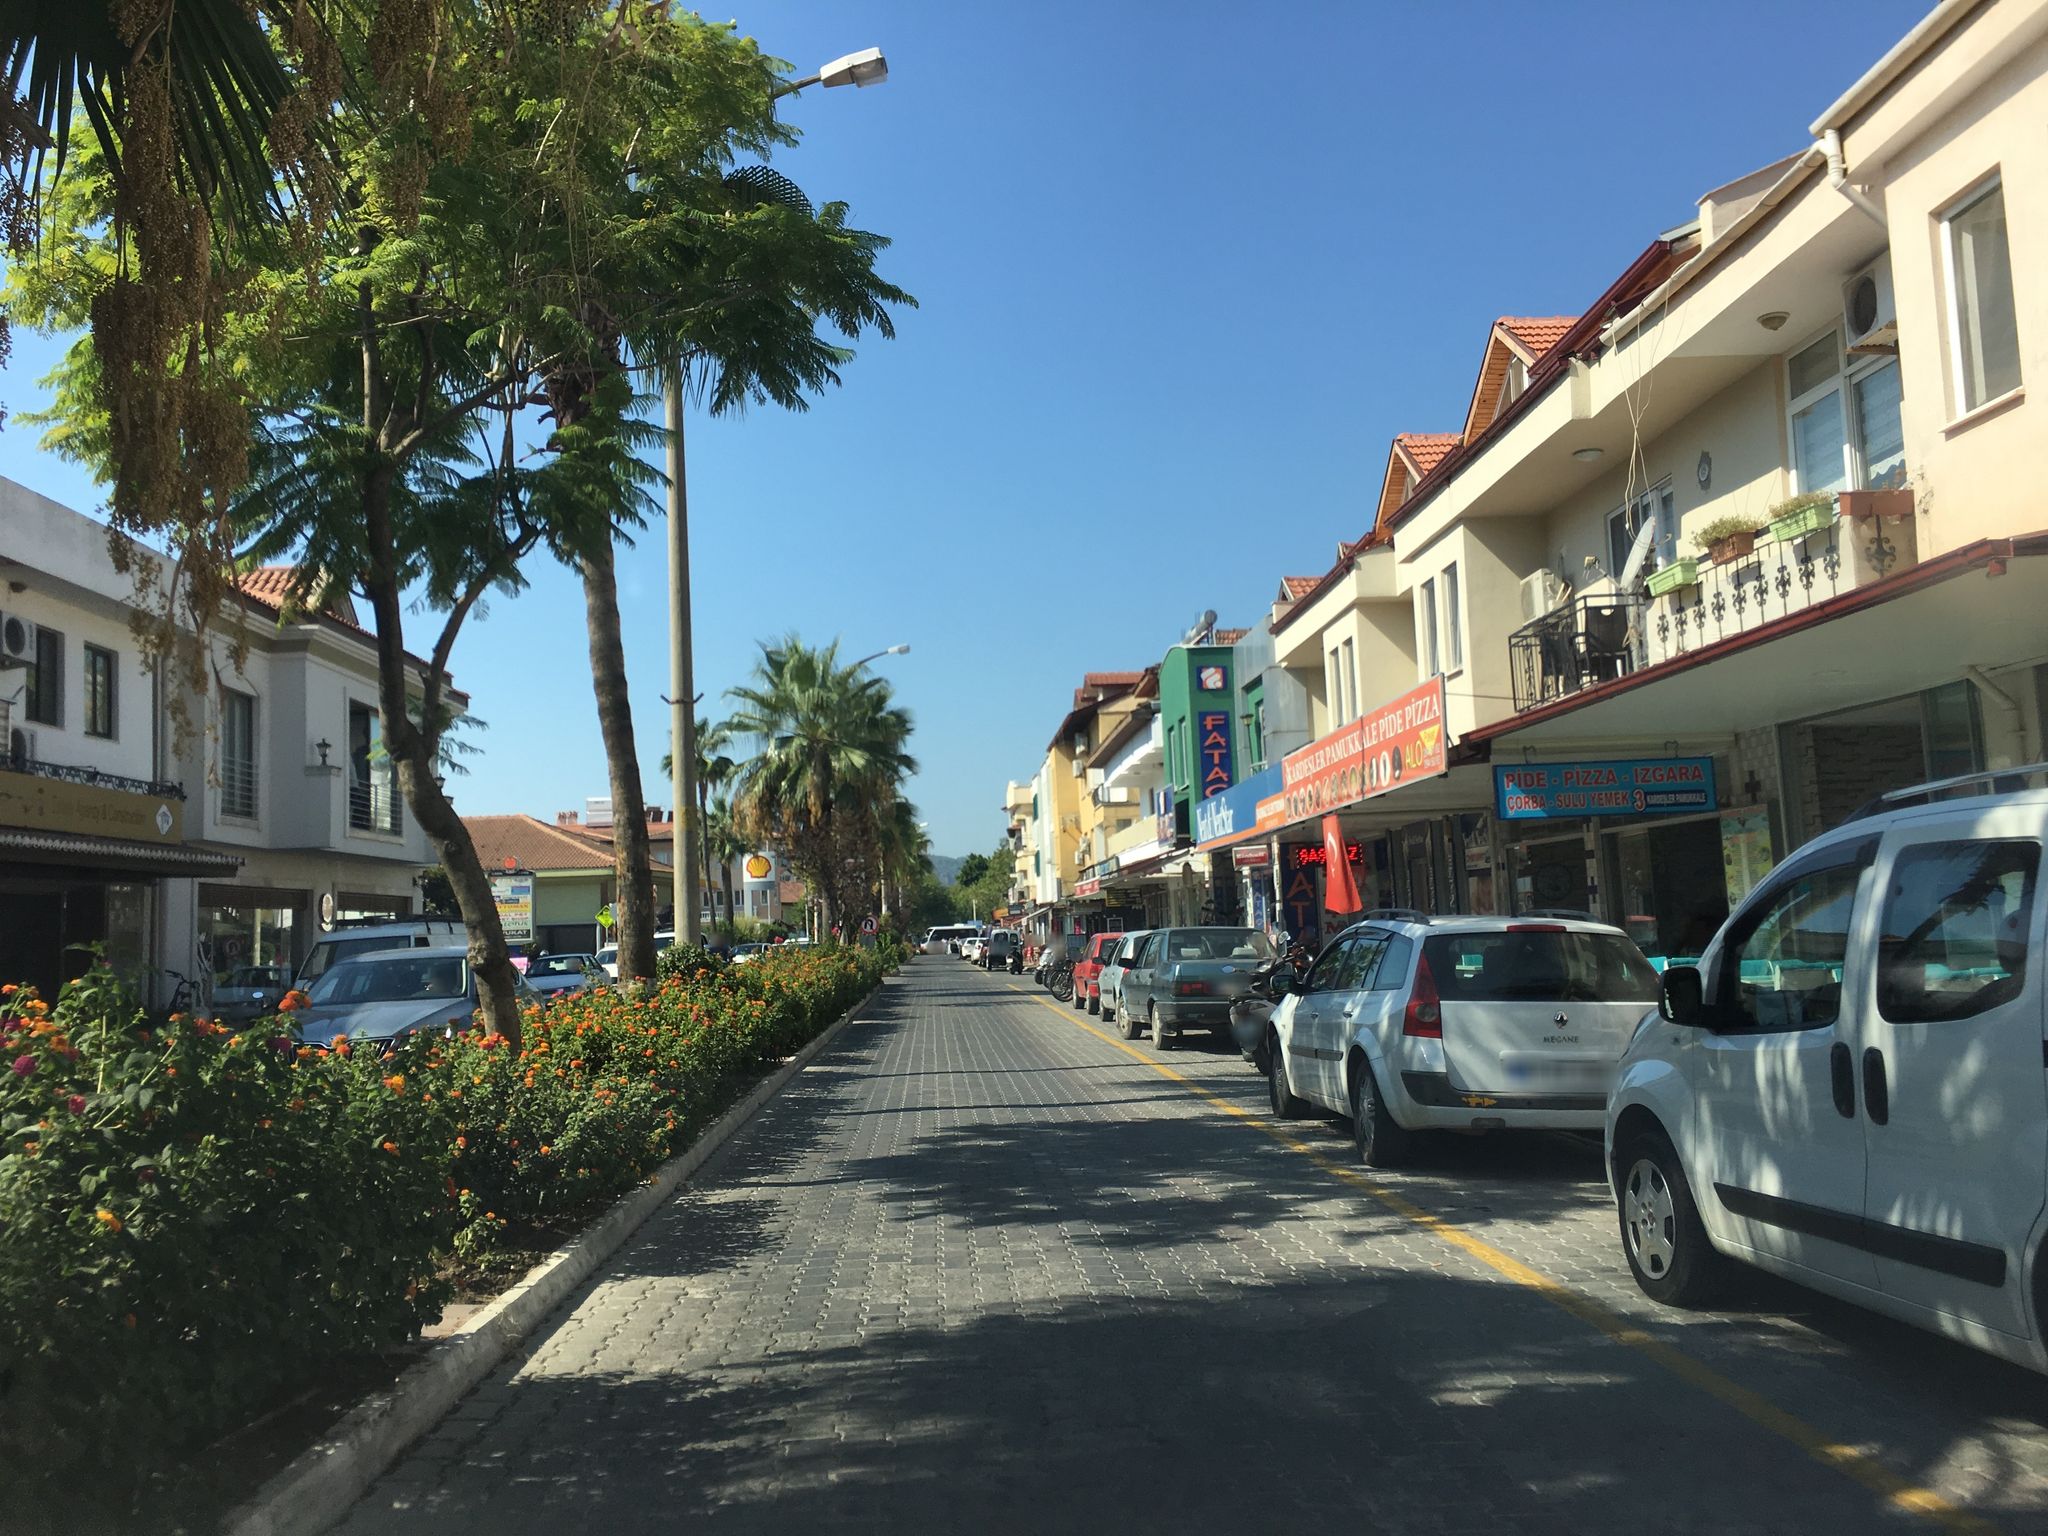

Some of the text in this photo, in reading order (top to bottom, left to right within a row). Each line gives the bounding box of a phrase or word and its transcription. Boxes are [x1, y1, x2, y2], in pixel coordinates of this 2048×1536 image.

[1325, 722, 1377, 765] PAMUKKALE
[1379, 710, 1403, 742] PİDE
[1405, 693, 1440, 729] PİZZA
[1505, 768, 1547, 789] PİDE
[1564, 767, 1618, 787] PİZZA
[1634, 765, 1703, 784] IZGARA
[1506, 794, 1546, 812] ÇORBA
[1555, 793, 1586, 810] SULU
[1589, 791, 1630, 808] YEMEK
[1633, 788, 1647, 811] 3
[1299, 845, 1358, 866] ŞAŞZ
